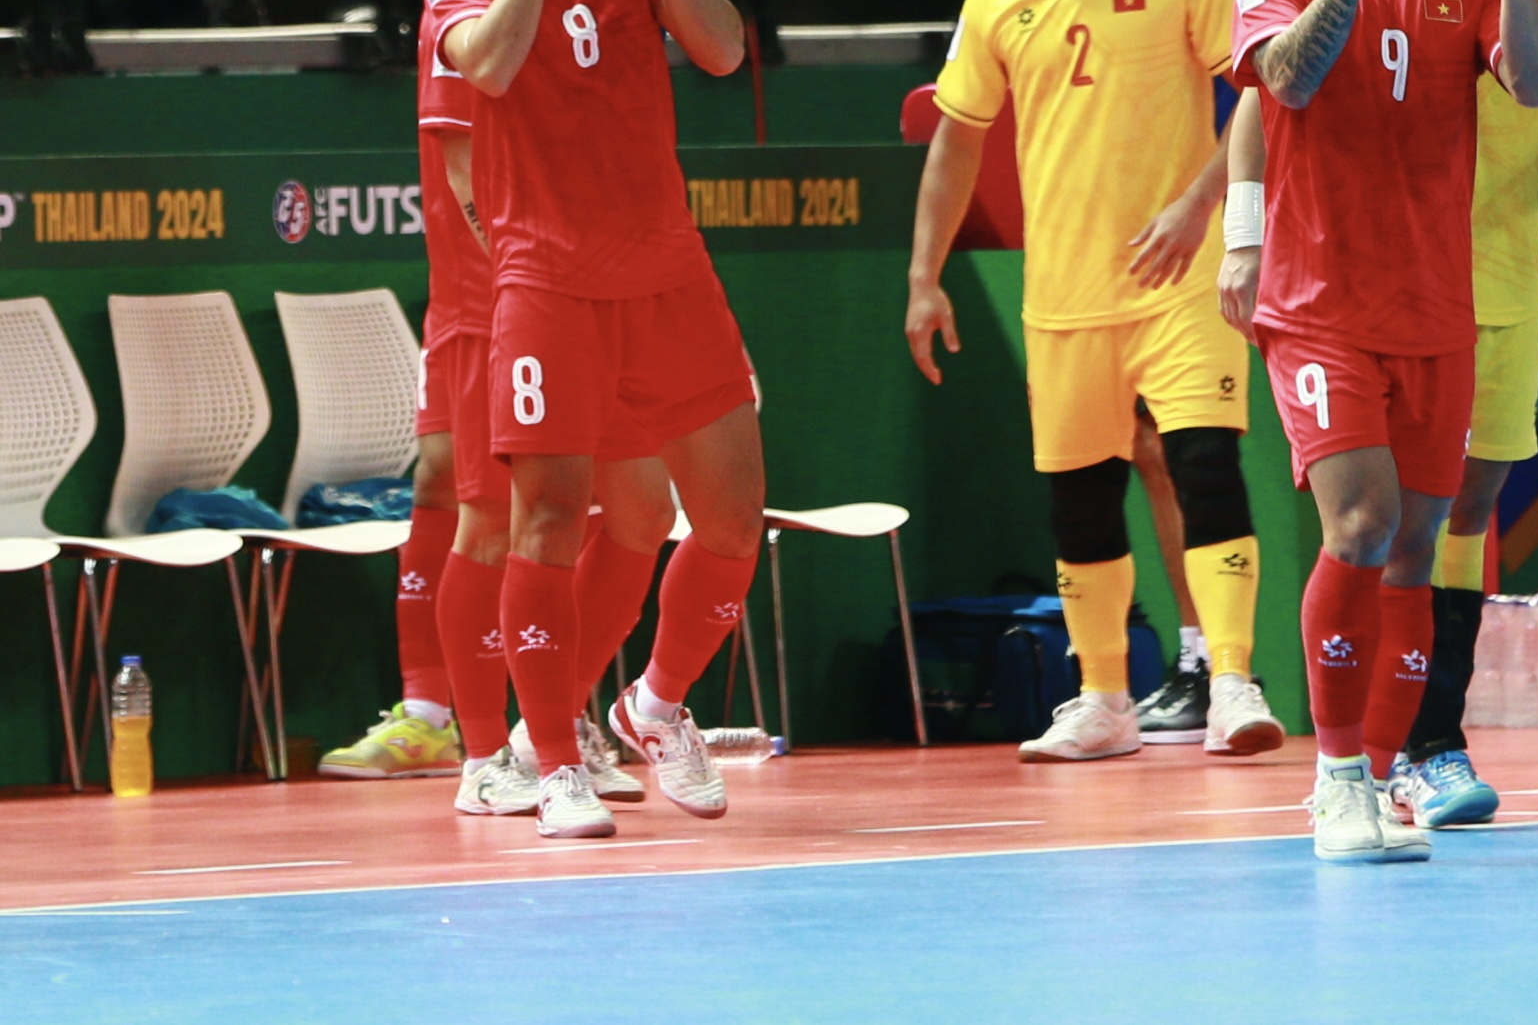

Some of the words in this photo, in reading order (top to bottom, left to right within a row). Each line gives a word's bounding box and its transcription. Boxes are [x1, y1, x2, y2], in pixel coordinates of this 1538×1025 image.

[562, 3, 600, 68] 8
[1066, 24, 1095, 87] 2
[1381, 28, 1409, 102] 9
[32, 190, 150, 243] THAILAND
[157, 187, 225, 240] 2024
[314, 187, 327, 235] AFC
[328, 183, 426, 236] FUTS
[688, 179, 794, 227] THAILAND
[800, 177, 860, 226] 2024
[512, 355, 546, 425] 8
[1296, 362, 1330, 430] 9
